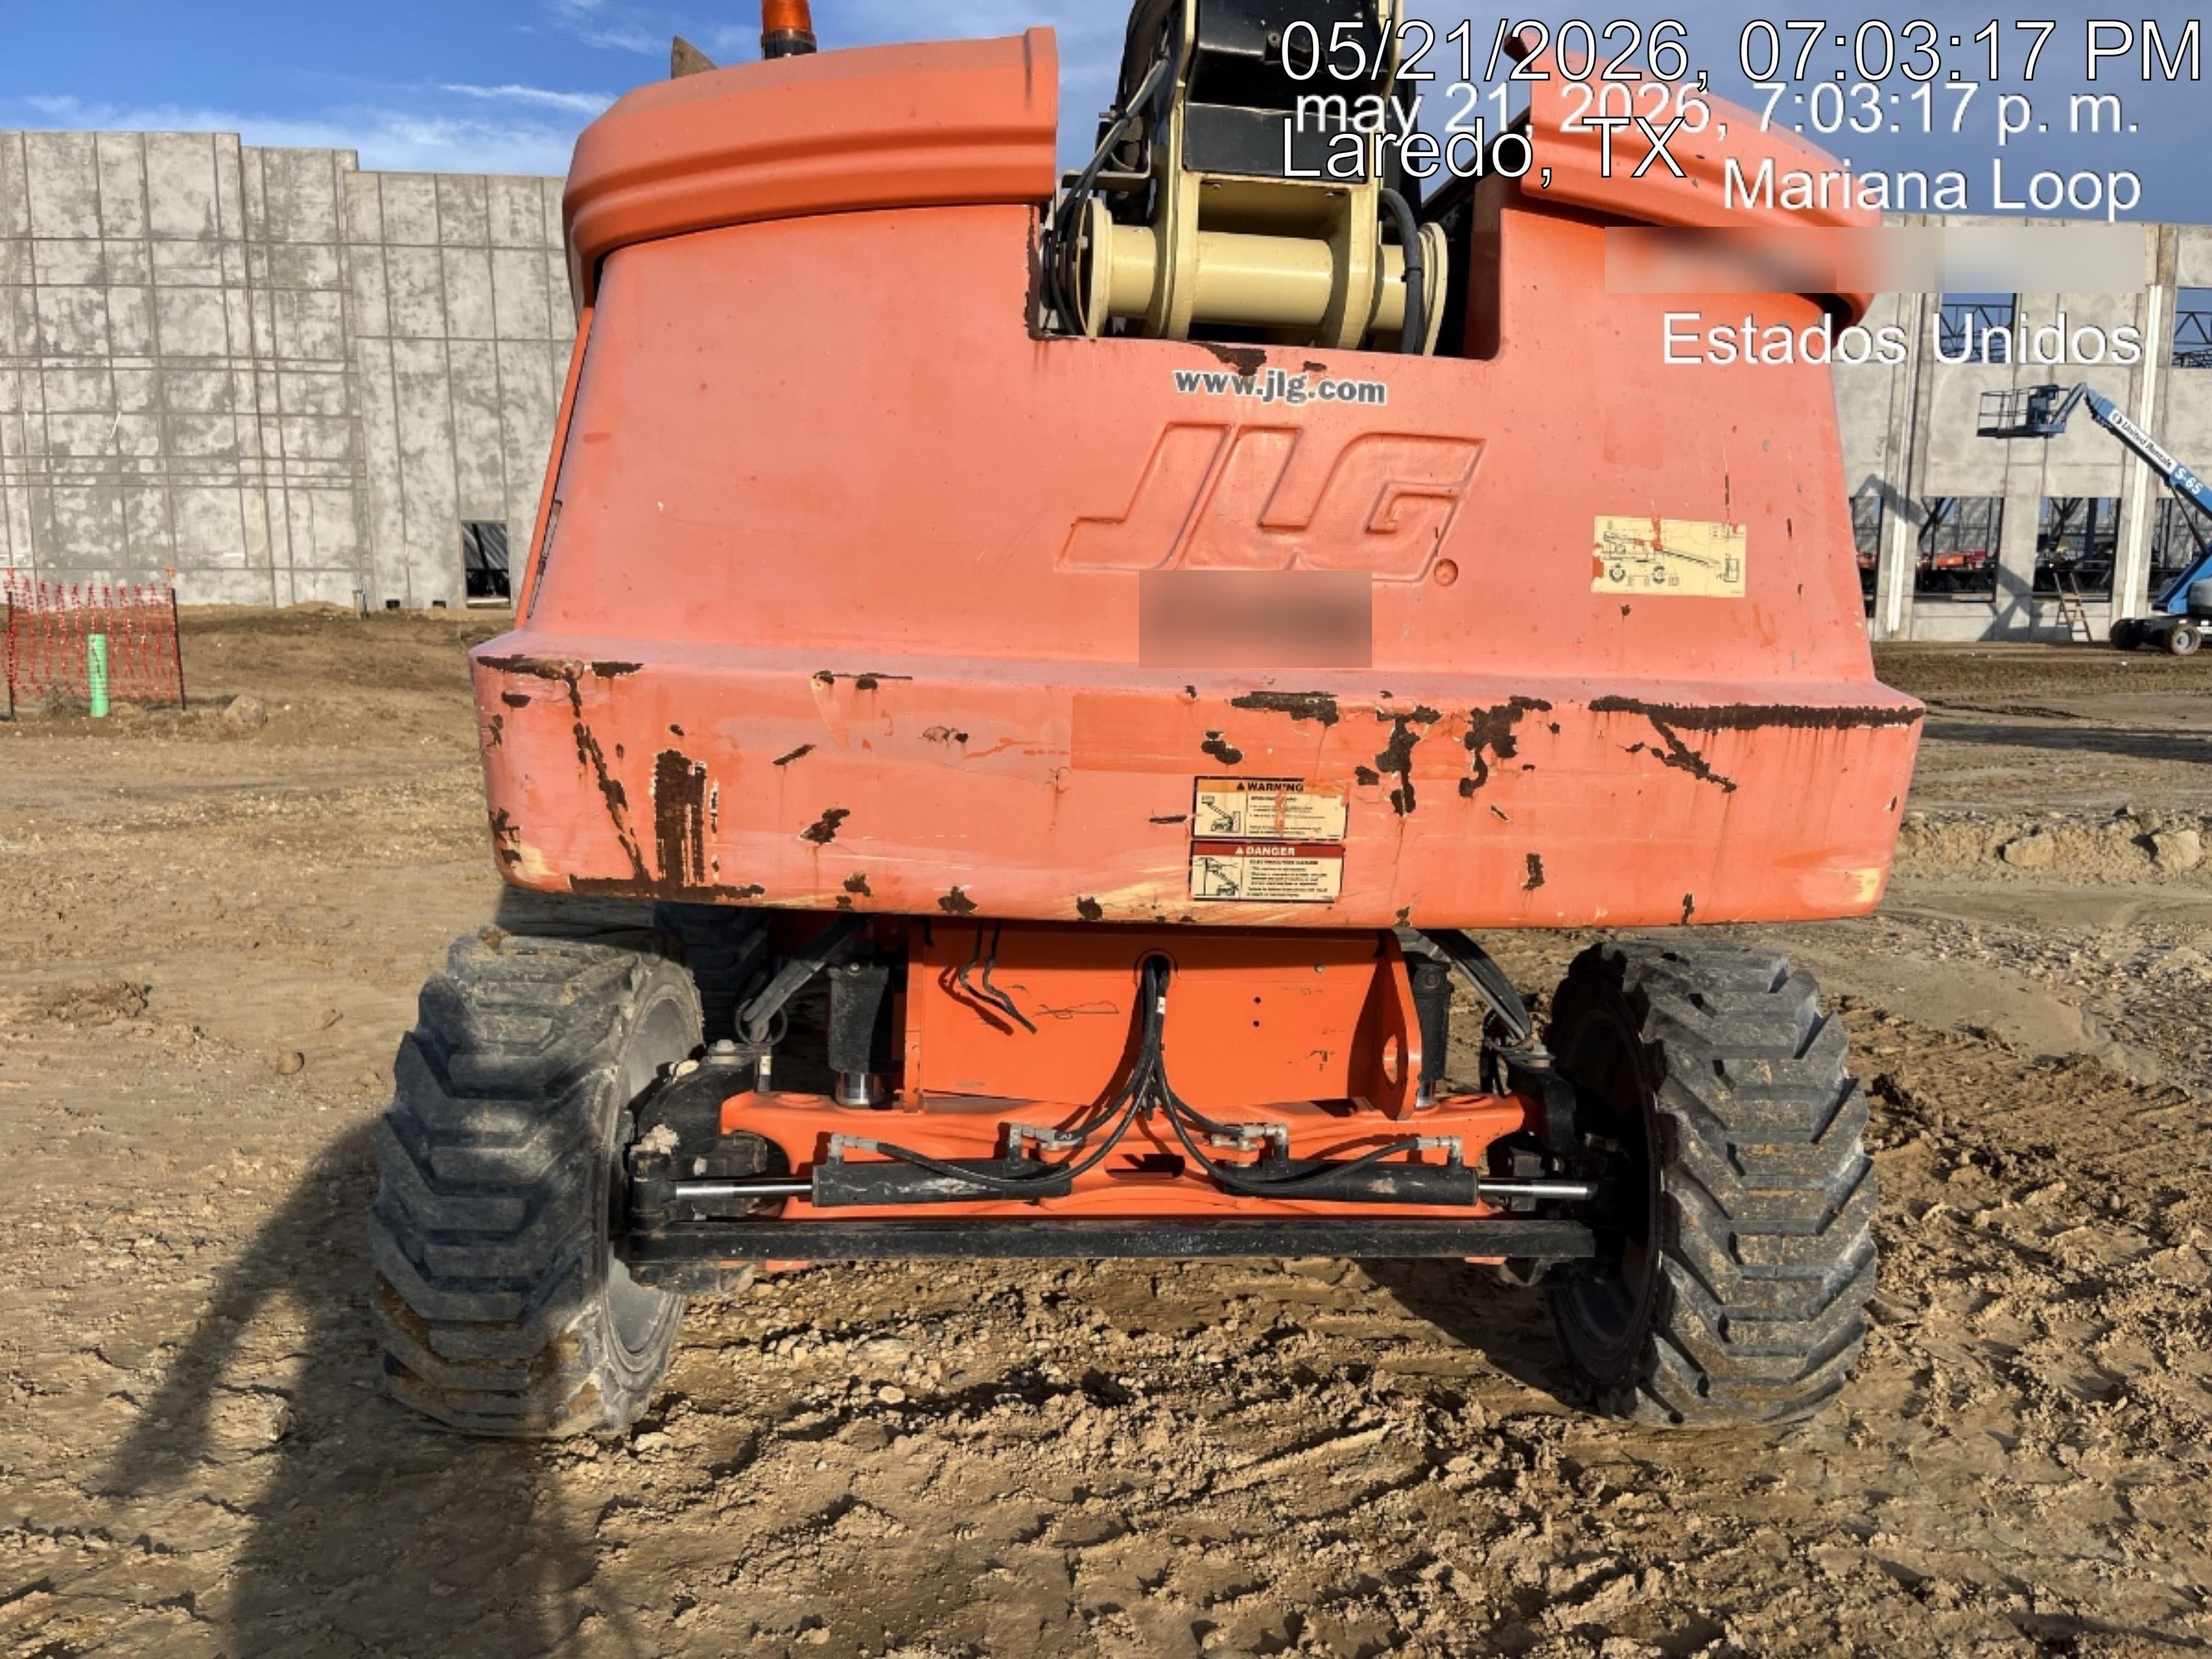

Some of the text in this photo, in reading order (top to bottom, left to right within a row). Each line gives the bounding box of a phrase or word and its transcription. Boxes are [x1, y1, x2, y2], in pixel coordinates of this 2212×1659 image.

[1174, 369, 1387, 406] www.jlg.com
[2122, 422, 2147, 447] United
[2175, 468, 2203, 495] S-65
[1054, 421, 1487, 583] JLG
[1245, 846, 1295, 856] DANGER
